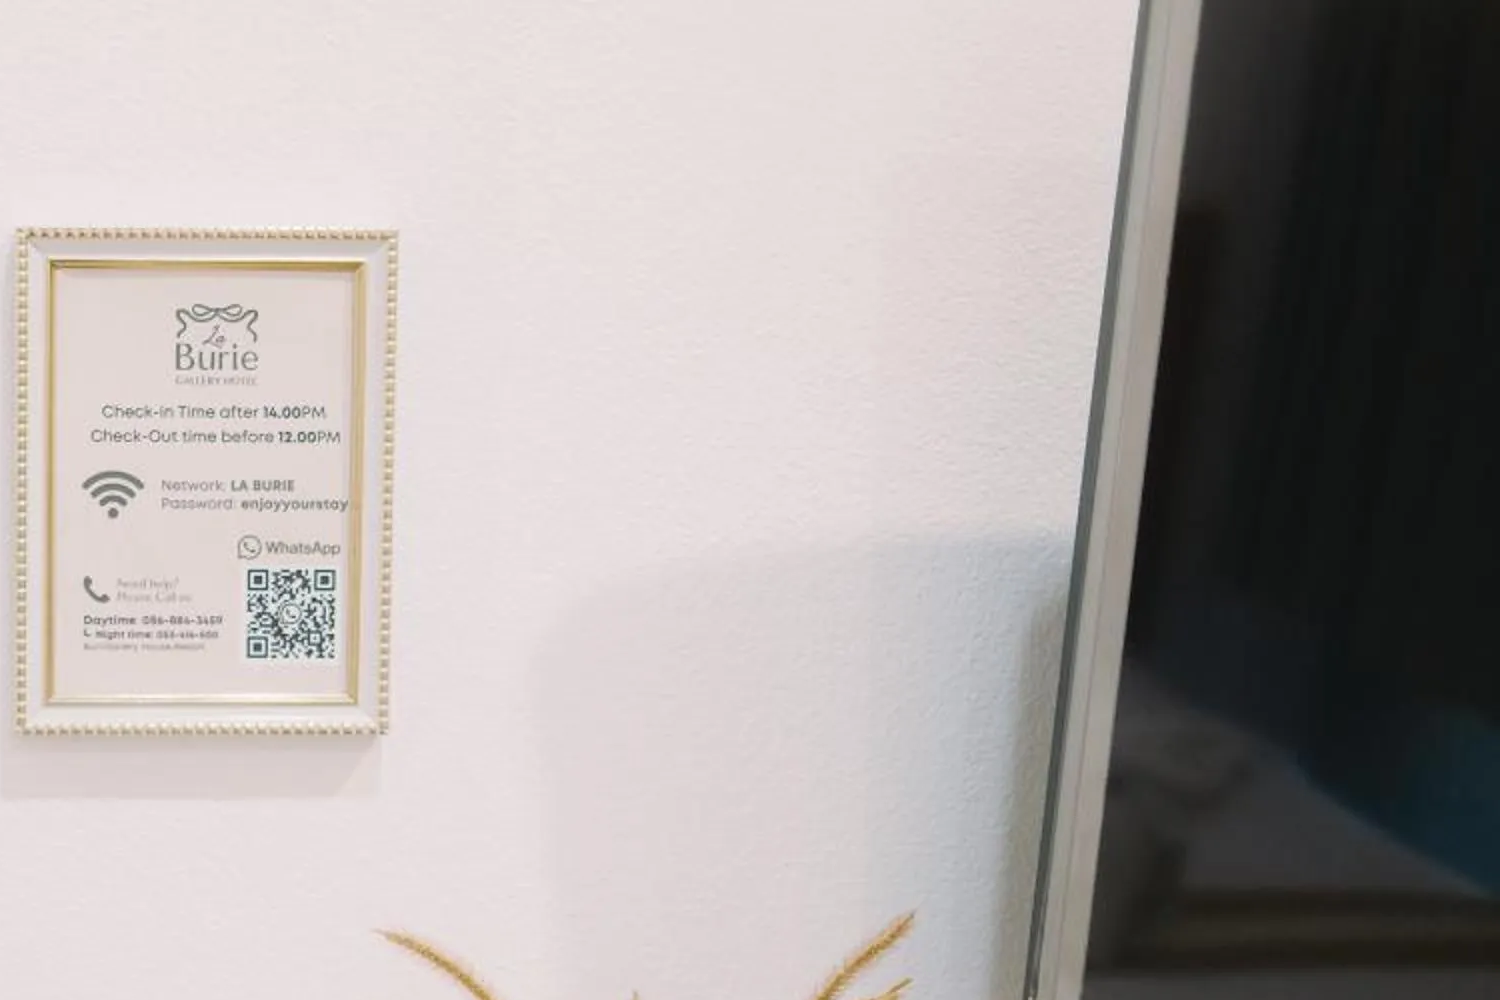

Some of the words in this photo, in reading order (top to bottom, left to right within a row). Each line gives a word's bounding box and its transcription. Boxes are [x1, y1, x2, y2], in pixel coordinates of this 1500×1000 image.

[202, 324, 224, 349] La
[175, 343, 258, 370] Burie
[102, 405, 174, 419] Check-in
[178, 405, 216, 419] Time
[220, 405, 258, 418] after
[263, 405, 327, 419] 14.00PM
[90, 428, 178, 443] Check-Out
[182, 428, 217, 443] time
[221, 428, 274, 443] before
[278, 429, 341, 443] 12.00PM
[231, 479, 248, 492] LA
[253, 479, 294, 492] BURIE
[241, 498, 349, 512] enjoyyourstay
[265, 541, 341, 556] WhatsApp
